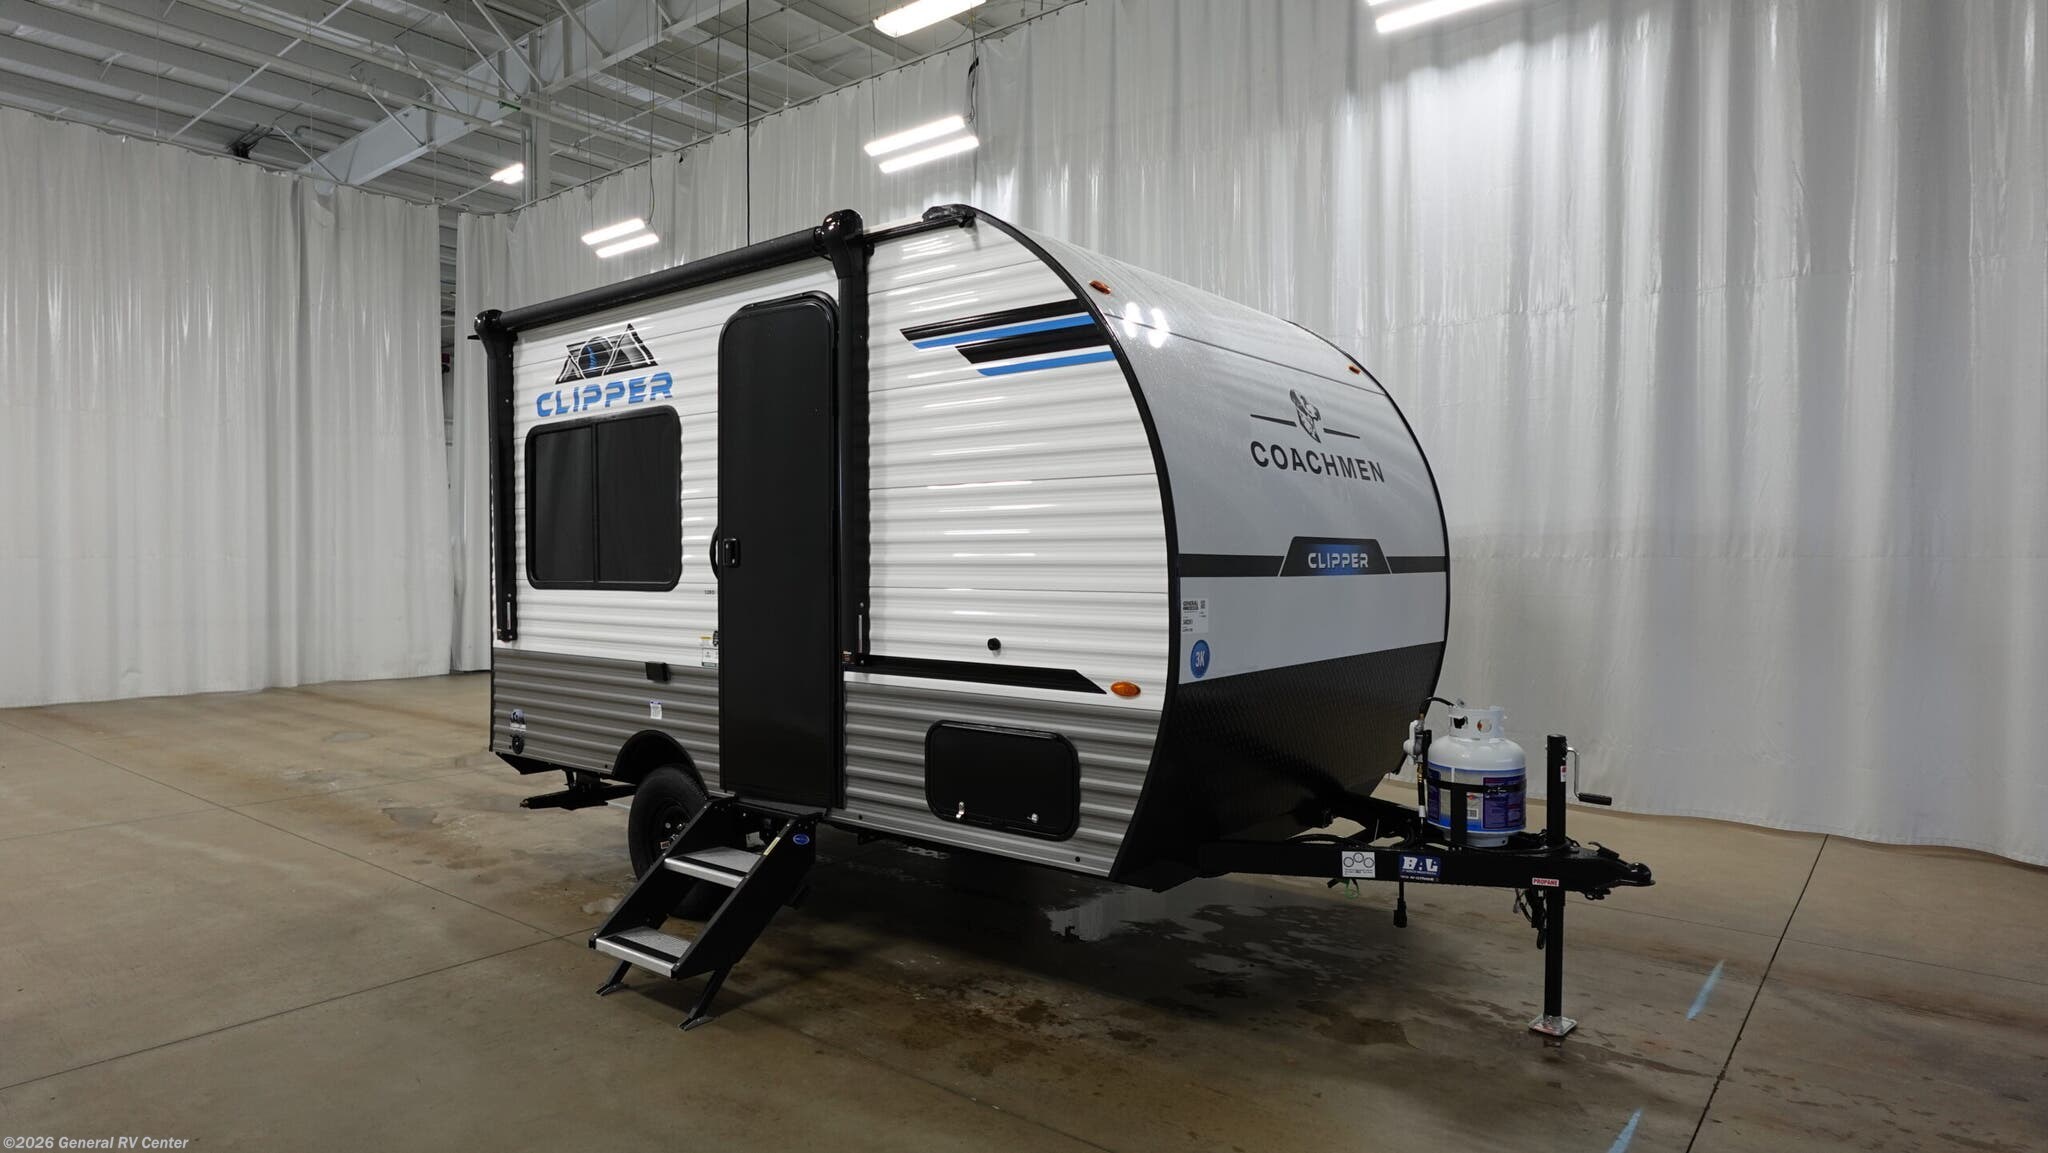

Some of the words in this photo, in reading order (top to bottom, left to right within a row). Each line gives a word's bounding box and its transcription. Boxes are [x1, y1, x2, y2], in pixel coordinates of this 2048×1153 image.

[536, 372, 673, 417] CLIPPER
[1250, 441, 1385, 482] COACHMEN
[1308, 552, 1369, 568] CLIPPER
[1533, 878, 1558, 886] PROPANE
